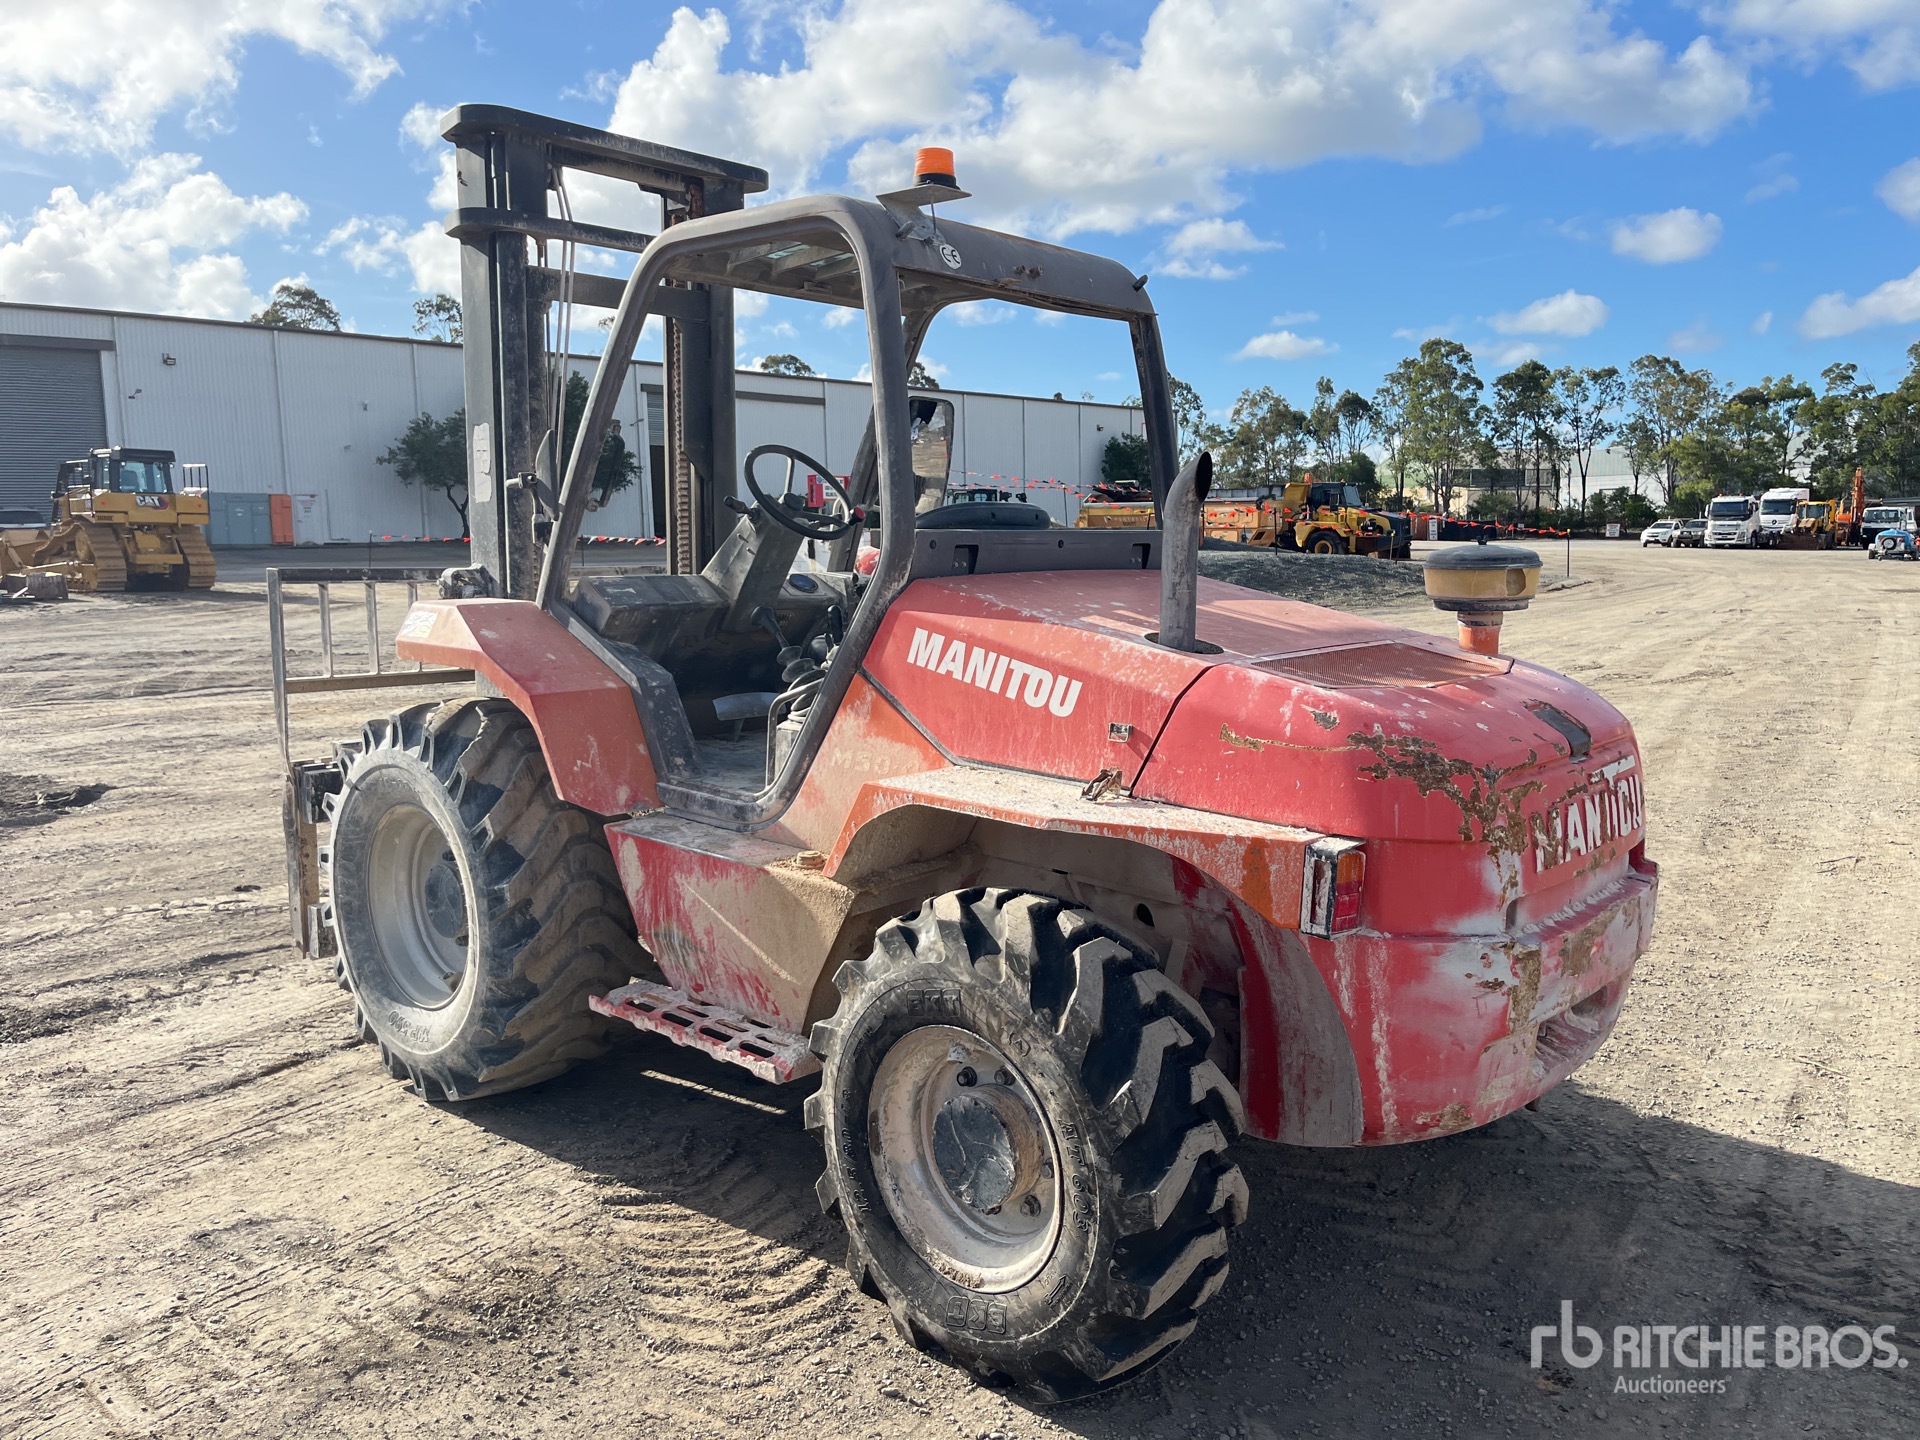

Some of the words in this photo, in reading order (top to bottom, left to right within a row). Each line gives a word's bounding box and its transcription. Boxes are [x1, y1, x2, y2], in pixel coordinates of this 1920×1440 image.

[135, 495, 161, 507] CAT
[906, 627, 1083, 718] MANITOU
[1532, 755, 1644, 873] MANITOU
[946, 1298, 1005, 1332] BKT
